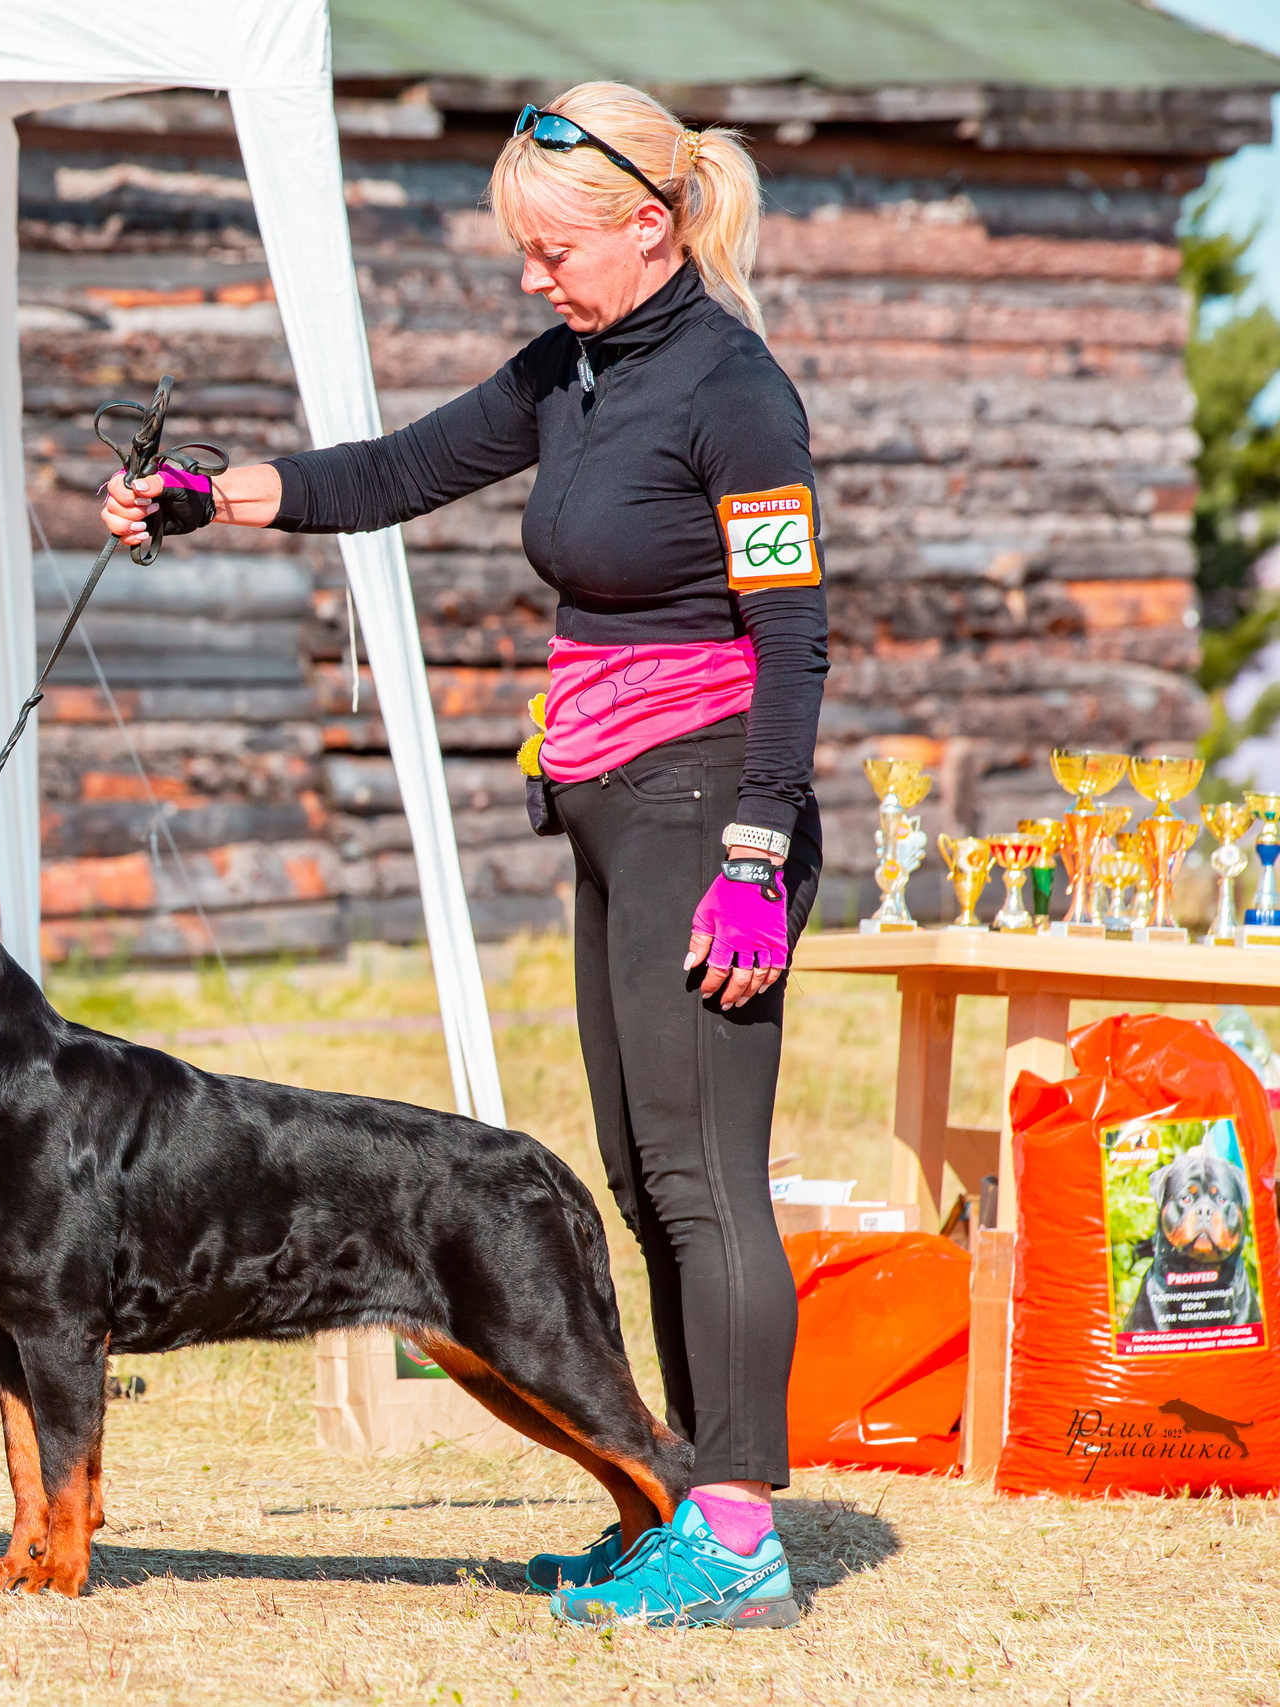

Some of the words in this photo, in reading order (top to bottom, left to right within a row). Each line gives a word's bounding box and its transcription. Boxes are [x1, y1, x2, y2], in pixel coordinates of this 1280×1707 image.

[731, 499, 801, 515] PROFIFEED
[745, 520, 802, 567] 66
[1181, 1301, 1206, 1312] КОРМ
